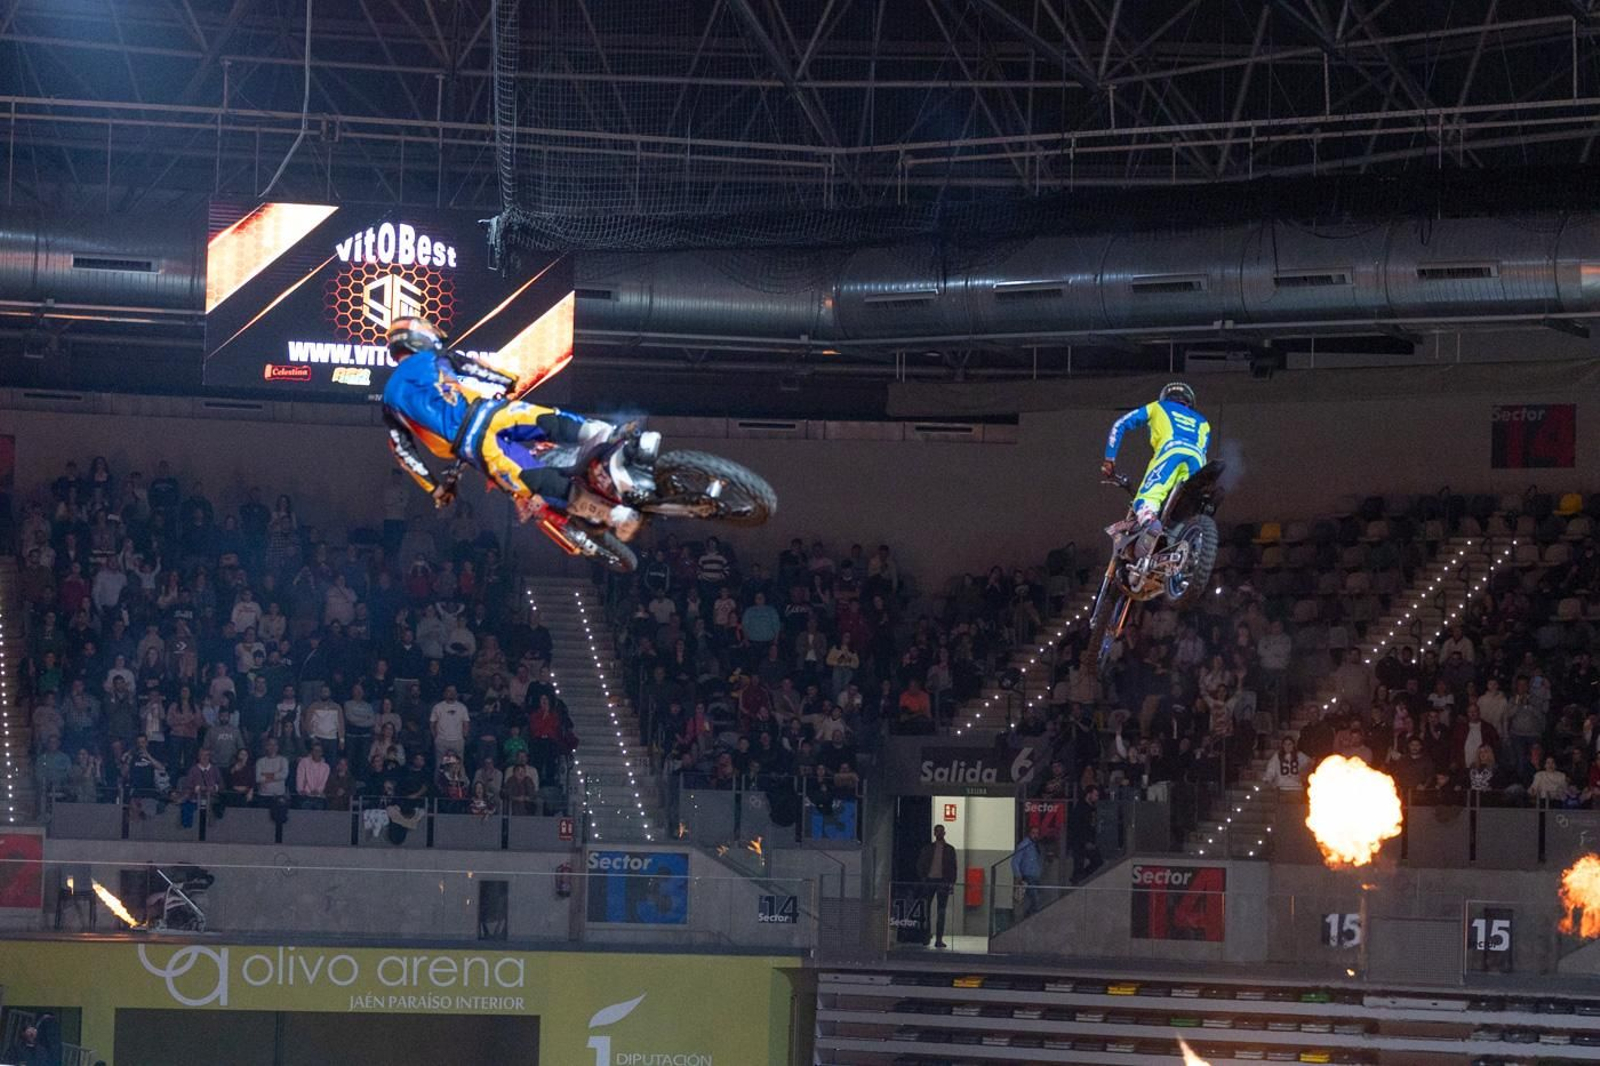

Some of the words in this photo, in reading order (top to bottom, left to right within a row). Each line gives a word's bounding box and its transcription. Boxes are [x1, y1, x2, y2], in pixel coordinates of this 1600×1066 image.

[335, 222, 457, 267] vitOBest
[1491, 407, 1545, 421] Sector
[921, 760, 998, 783] Salida
[1010, 747, 1034, 783] 6
[1024, 801, 1059, 813] Sector
[586, 852, 653, 870] Sector
[605, 851, 689, 924] 13
[1132, 866, 1192, 885] Sector
[758, 913, 789, 922] Sector
[762, 895, 800, 923] 14
[1148, 867, 1226, 942] 14
[1325, 913, 1362, 948] 15
[1472, 918, 1510, 951] 15
[242, 946, 359, 986] olivo
[377, 956, 525, 988] arena
[349, 992, 385, 1011] JAÉN
[388, 992, 451, 1009] PARAÍSO
[456, 996, 525, 1010] INTERIOR
[616, 1052, 713, 1066] DIPUTACIÓN
